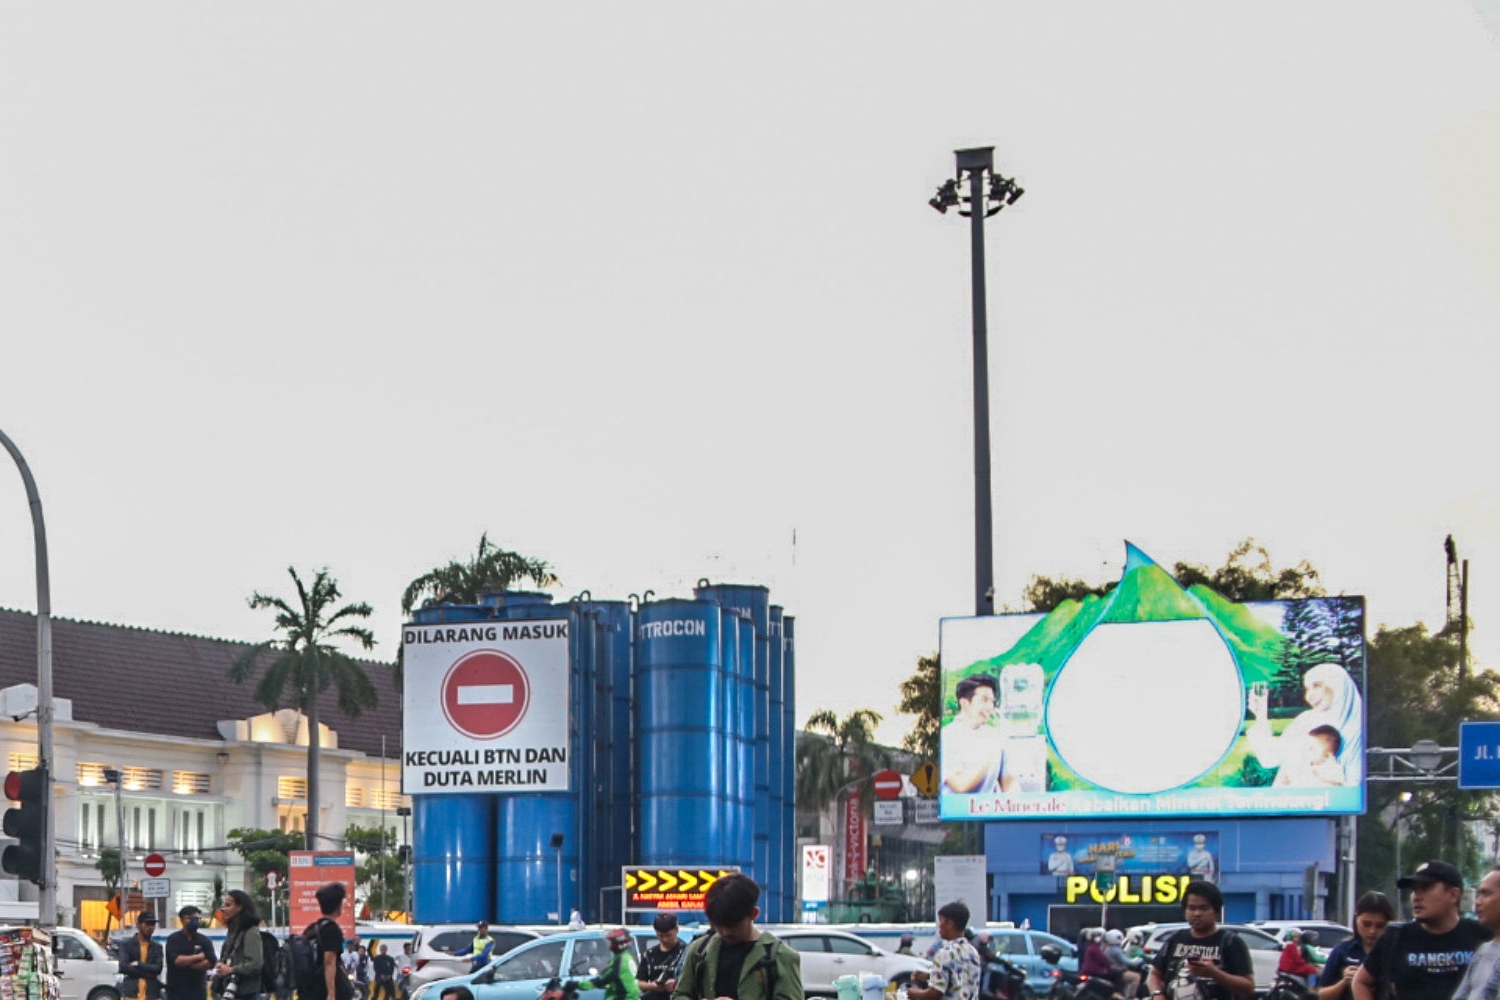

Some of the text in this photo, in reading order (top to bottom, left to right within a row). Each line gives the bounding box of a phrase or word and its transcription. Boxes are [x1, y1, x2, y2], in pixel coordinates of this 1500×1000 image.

[405, 624, 568, 645] DILARANG MASUK
[405, 747, 567, 767] KECUALI BTN DAN
[1474, 744, 1494, 760] Jl.
[424, 769, 547, 787] DUTA MERLIN
[969, 797, 989, 814] Le
